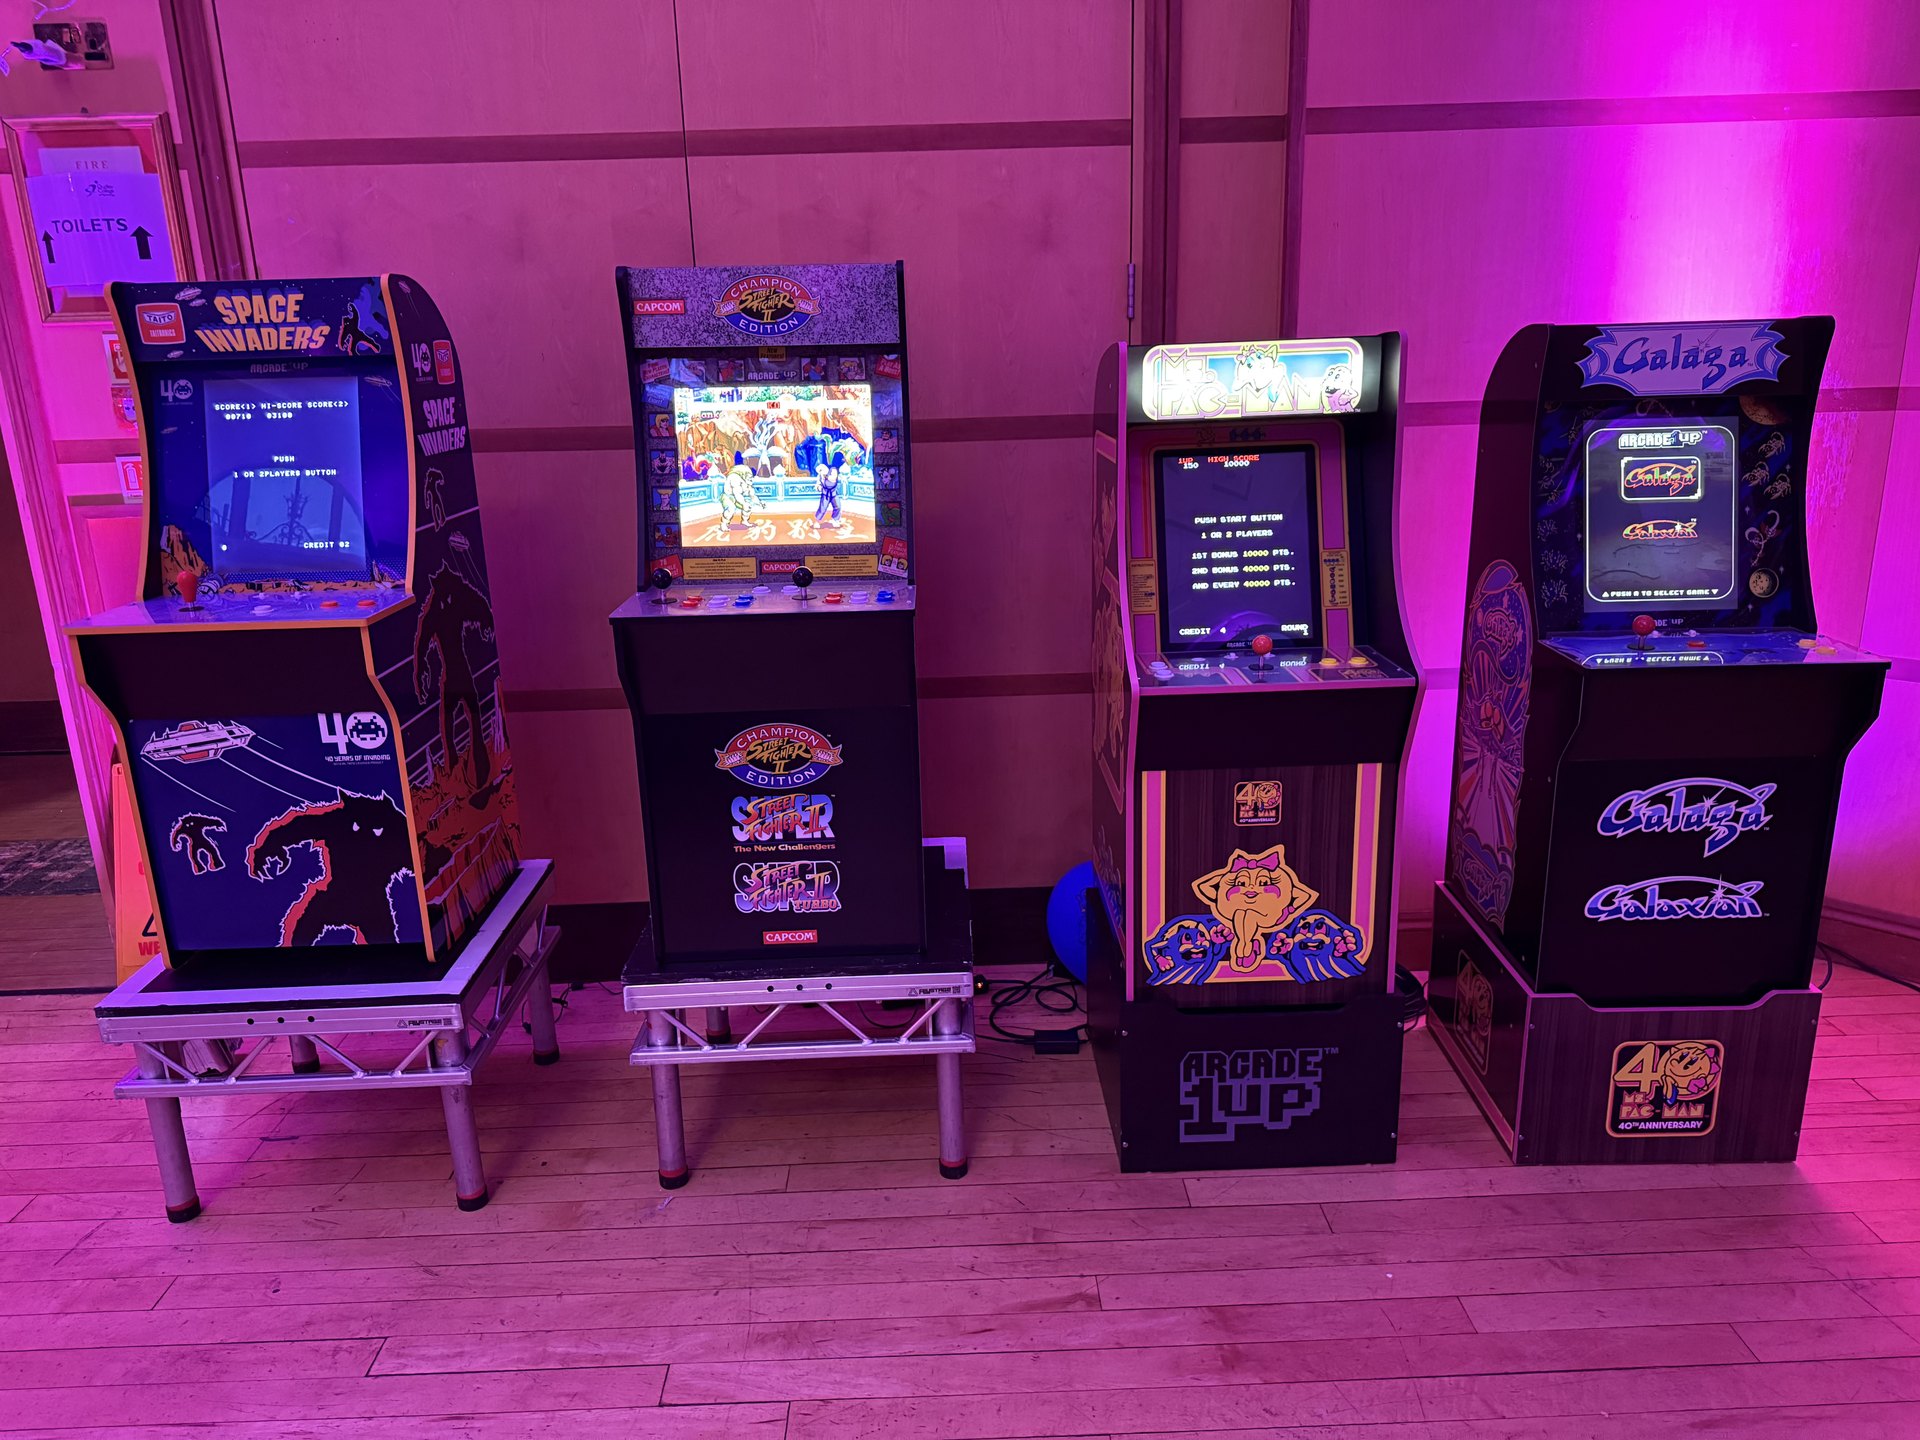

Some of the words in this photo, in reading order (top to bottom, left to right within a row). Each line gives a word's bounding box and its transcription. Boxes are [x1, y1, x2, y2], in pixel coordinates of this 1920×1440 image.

[75, 160, 109, 170] FIRE
[51, 218, 128, 234] TOILETS
[730, 278, 801, 298] CHAMPION
[739, 287, 776, 309] STREET
[747, 293, 795, 312] FIGHTER
[213, 290, 305, 326] SPACE
[636, 302, 681, 312] CAPCOM
[146, 313, 175, 324] TAITO
[739, 317, 799, 333] EDITION
[194, 324, 331, 353] INVADERS
[1611, 331, 1750, 391] Galaga
[747, 371, 779, 381] ARCADE
[1156, 374, 1324, 419] PAC-MAN
[214, 403, 257, 411] SCORE<1>
[260, 401, 303, 410] HI-SCORE
[307, 400, 349, 409] SCORE<2>
[422, 396, 456, 428] SPACE
[417, 425, 467, 457] INVADERS
[273, 455, 295, 463] PUSH
[1178, 457, 1194, 465] 1UP
[1207, 455, 1230, 463] HIGH
[1233, 454, 1260, 462] SCORE
[1183, 462, 1199, 470] 150
[1223, 460, 1251, 468] 10000
[233, 471, 239, 479] 1
[243, 470, 255, 478] OR
[259, 469, 301, 478] 2PLAYERS
[305, 468, 337, 477] BUTTON
[1624, 462, 1697, 496] Galaga
[1194, 516, 1217, 525] PUSH
[1219, 515, 1247, 523] START
[1250, 513, 1284, 522] BUTTON
[1210, 531, 1223, 539] OR
[1225, 531, 1233, 539] 2
[1235, 529, 1274, 538] PLAYERS
[303, 541, 335, 549] CREDIT
[338, 541, 350, 549] 02
[1191, 552, 1208, 560] 1ST
[1211, 551, 1239, 559] BONUS
[1242, 549, 1269, 558] 10000
[1272, 548, 1295, 557] PTS.
[763, 562, 797, 572] CAPCOM
[1191, 567, 1209, 575] 2ND
[1211, 566, 1239, 574] BONUS
[1242, 564, 1270, 573] 40000
[1273, 563, 1295, 572] PTS.
[1191, 582, 1209, 590] AND
[1212, 581, 1240, 589] EVERY
[1243, 579, 1271, 588] 40000
[1273, 578, 1296, 587] PTS.
[1653, 589, 1685, 597] SELECT
[1686, 588, 1710, 596] GAME
[1179, 627, 1211, 636] CREDIT
[1219, 626, 1227, 634] 4
[1280, 623, 1309, 632] ROUND
[736, 727, 820, 749] CHAMPION
[746, 737, 790, 760] STREET
[754, 741, 812, 764] FIGHTER
[334, 754, 354, 762] YEARS
[363, 753, 391, 761] INVADING
[745, 767, 817, 786] EDITION
[739, 793, 810, 825] STREET
[745, 809, 808, 841] FIGHTER
[1596, 776, 1778, 859] Galaga
[733, 845, 752, 853] The
[753, 844, 777, 852] New
[778, 843, 836, 852] Challengers
[743, 860, 813, 894] STREET
[748, 878, 813, 910] FIGHTER
[1583, 873, 1765, 922] Galaxian
[793, 898, 839, 912] TURBO
[765, 931, 815, 942] CAPCOM
[138, 941, 161, 957] WE
[1179, 1048, 1323, 1081] ARCADE
[1178, 1078, 1321, 1143] 1UP
[1618, 1101, 1706, 1119] PAC-MAN
[1638, 1120, 1703, 1130] ANNIVERSARY
